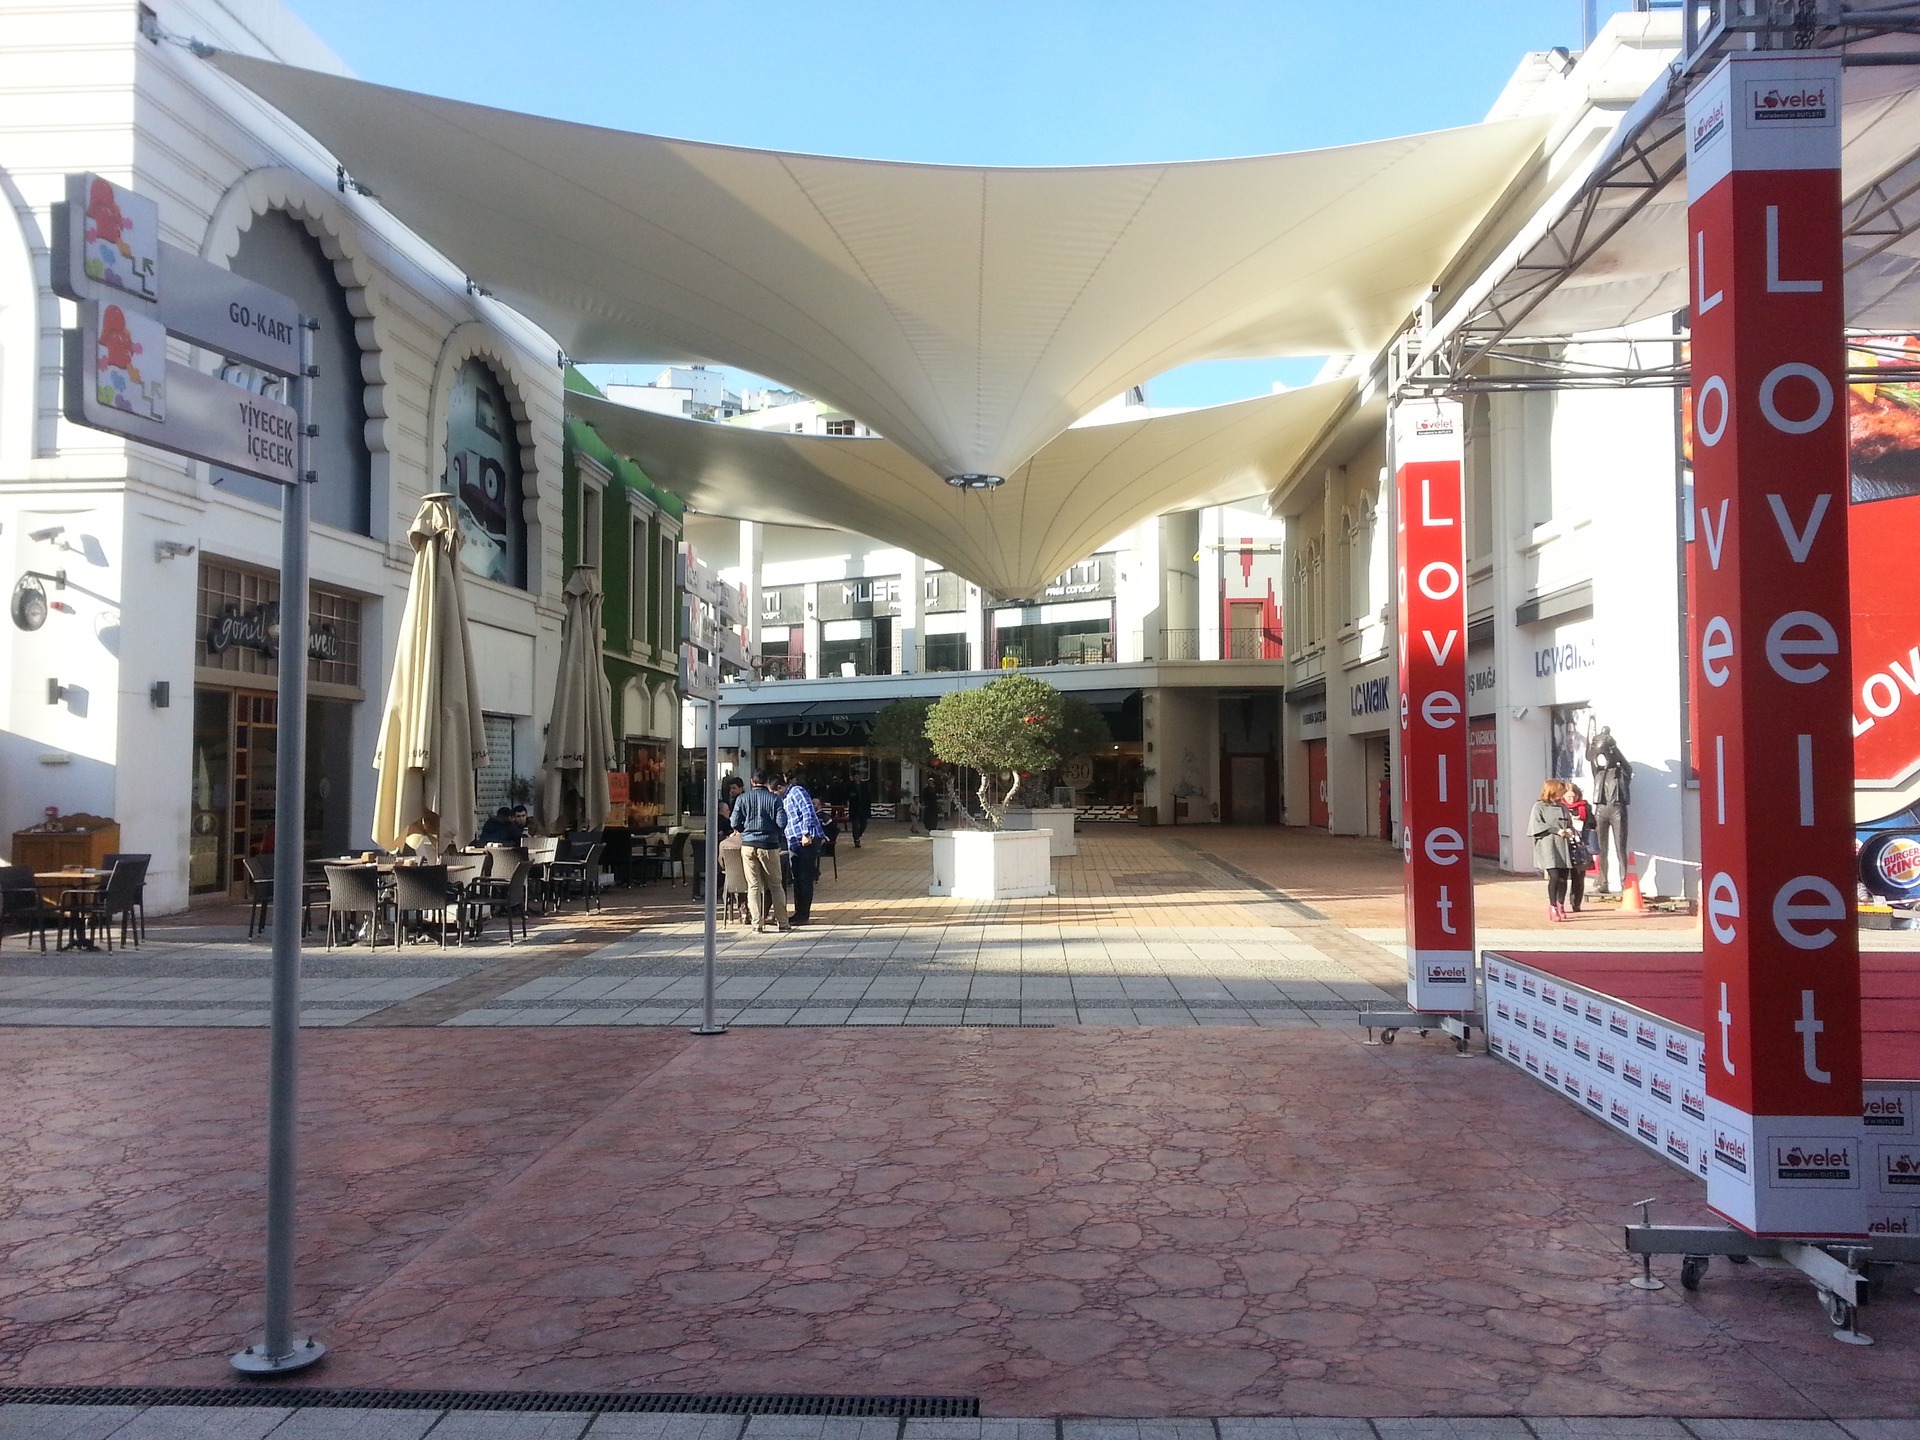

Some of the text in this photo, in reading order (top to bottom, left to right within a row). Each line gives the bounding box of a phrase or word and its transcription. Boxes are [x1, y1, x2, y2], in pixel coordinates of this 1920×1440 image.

[1754, 89, 1826, 109] Lovelet
[229, 302, 293, 345] GO-KART
[239, 400, 293, 442] YİYECEK
[1416, 418, 1453, 430] Lovelet
[247, 429, 293, 468] İÇECEK
[787, 718, 873, 738] DESA
[1884, 847, 1920, 867] BURGER
[1886, 855, 1920, 878] KING
[1427, 966, 1466, 977] Lovelet
[1666, 1033, 1688, 1056] Lovelet
[1681, 1087, 1704, 1112] Lovelet
[1667, 1128, 1689, 1152] Lovelet
[1714, 1128, 1746, 1162] Lovelet
[1777, 1147, 1850, 1167] Lovelet
